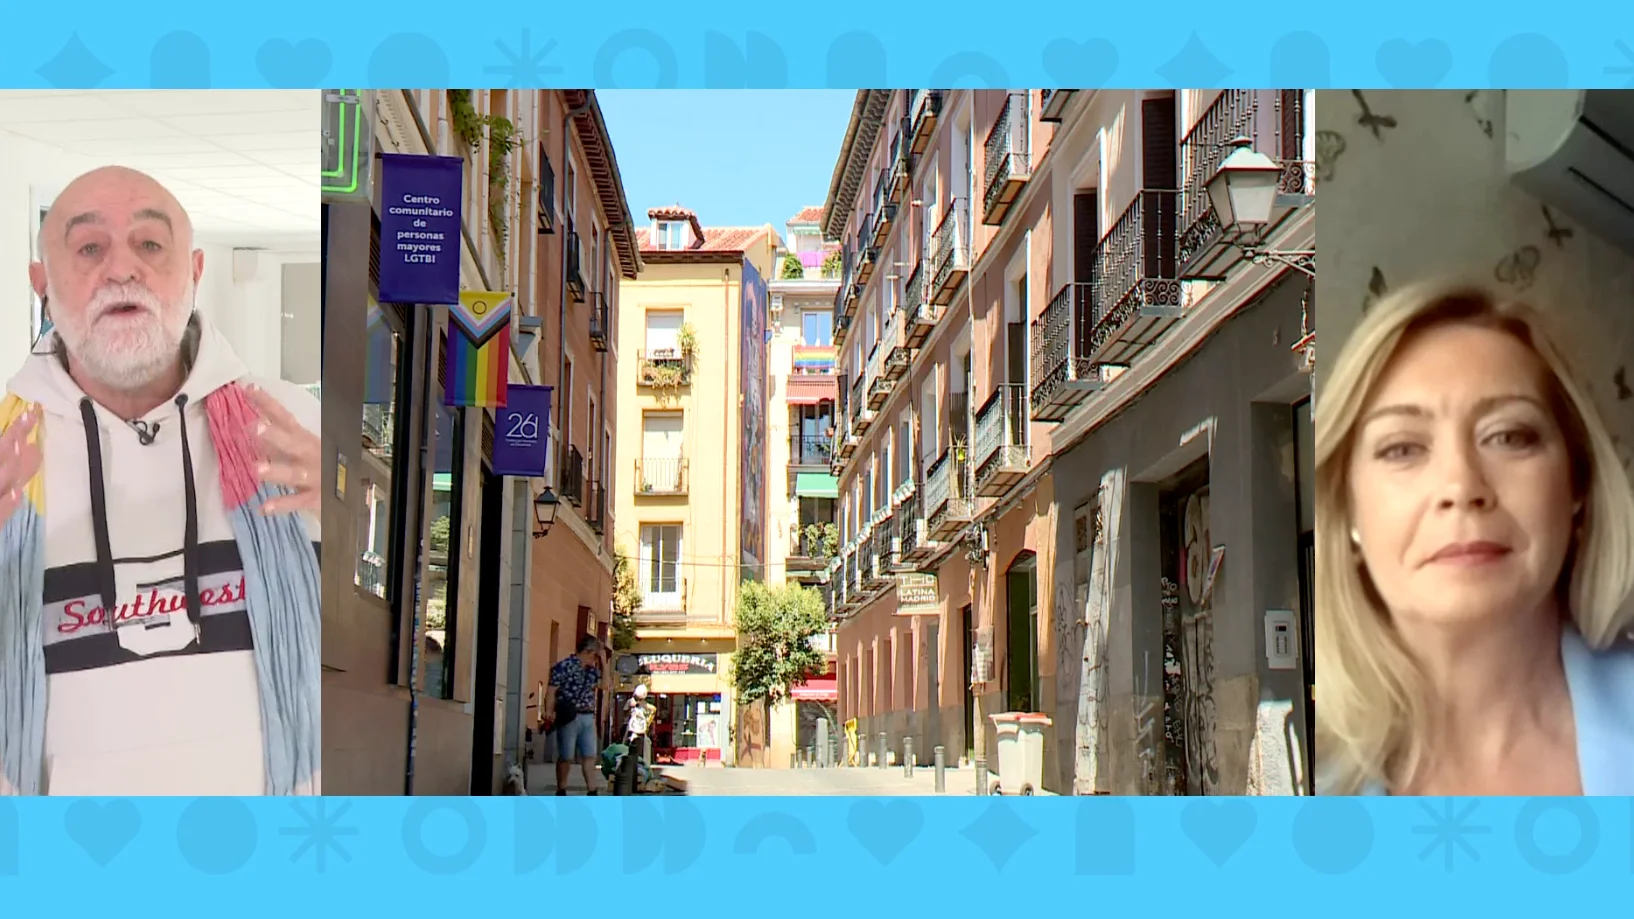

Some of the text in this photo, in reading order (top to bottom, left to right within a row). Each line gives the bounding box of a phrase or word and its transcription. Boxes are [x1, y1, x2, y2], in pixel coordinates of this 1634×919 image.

[403, 194, 440, 205] Centro
[389, 207, 454, 217] comunitario
[413, 219, 427, 228] de
[397, 231, 445, 240] personas
[397, 243, 442, 253] mayores
[404, 253, 436, 264] LGTBI
[900, 588, 935, 596] LATINA
